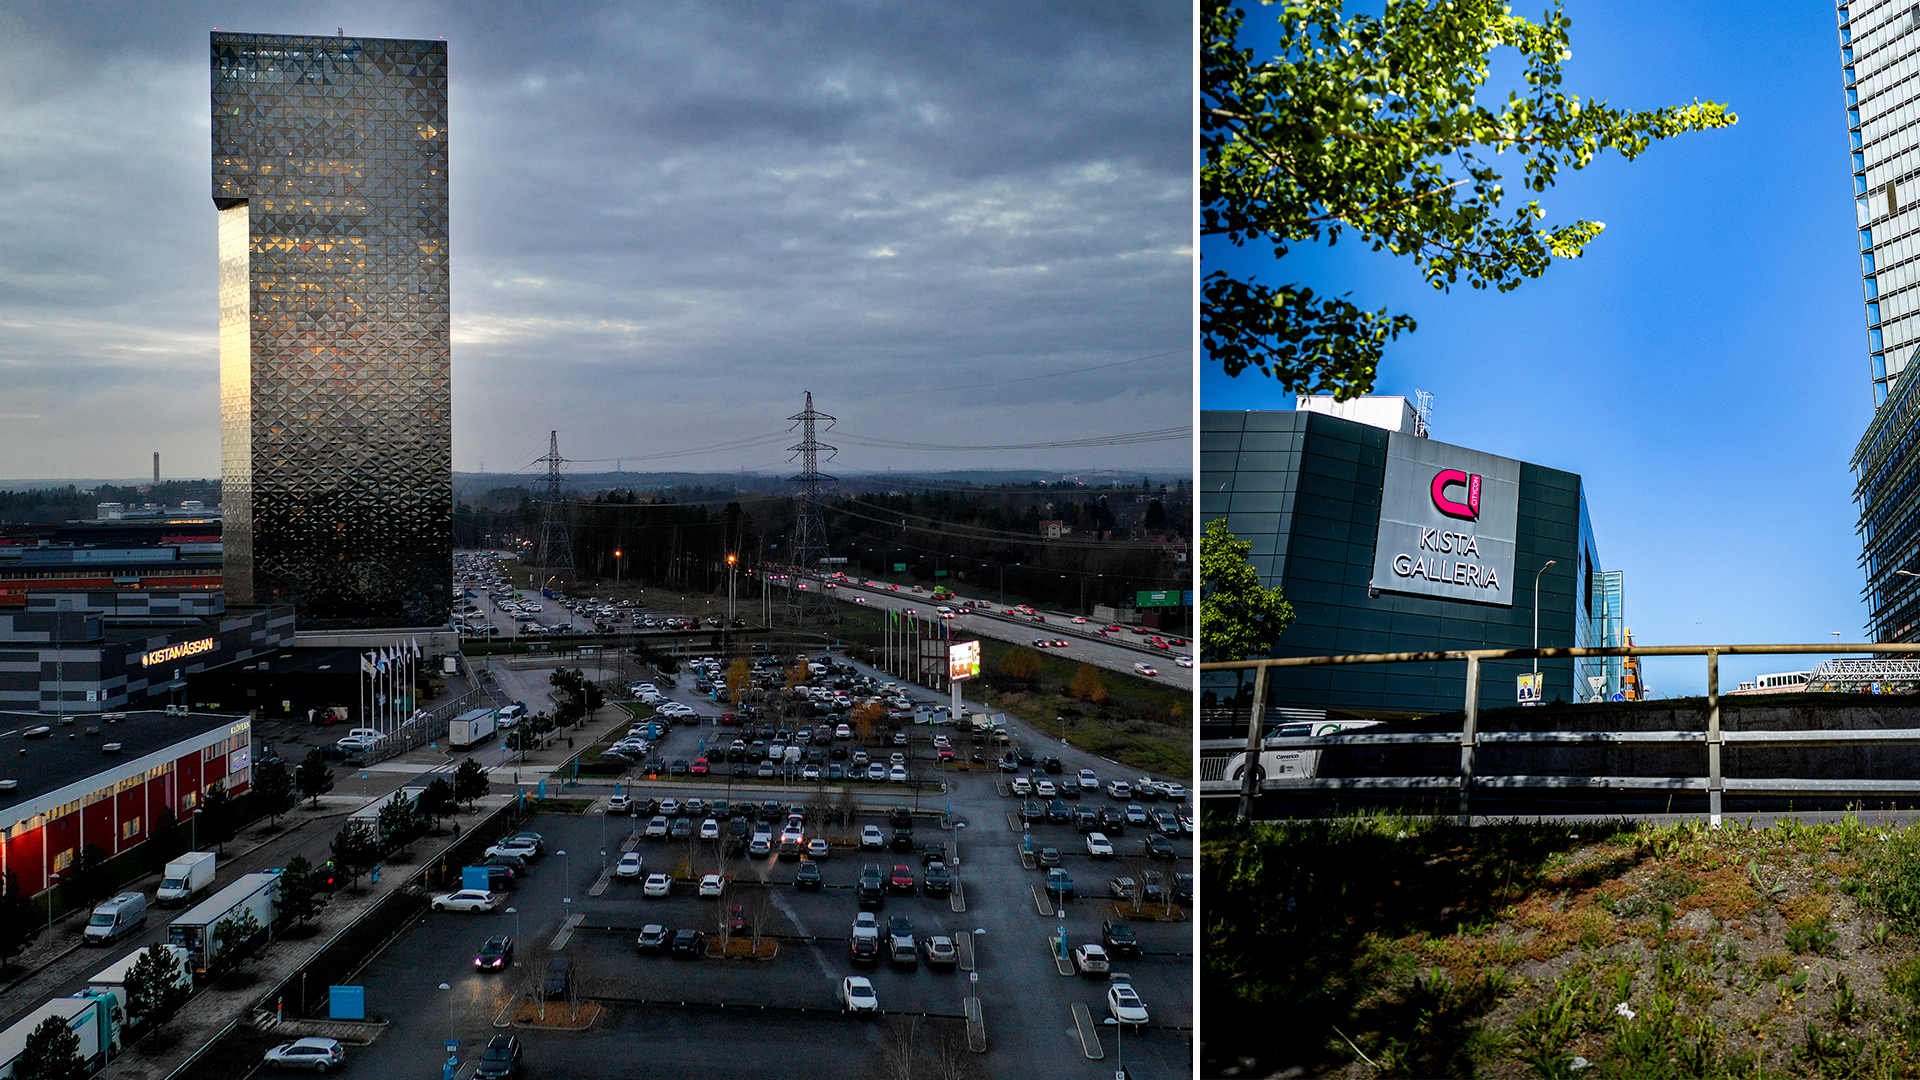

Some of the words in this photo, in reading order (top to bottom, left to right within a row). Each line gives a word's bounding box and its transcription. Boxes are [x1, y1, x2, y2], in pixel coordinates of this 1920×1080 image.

[1471, 476, 1479, 506] CITYCON
[1420, 527, 1480, 558] KISTA
[1392, 553, 1500, 590] GALLERIA
[149, 638, 213, 665] KISTAMÄSSAN
